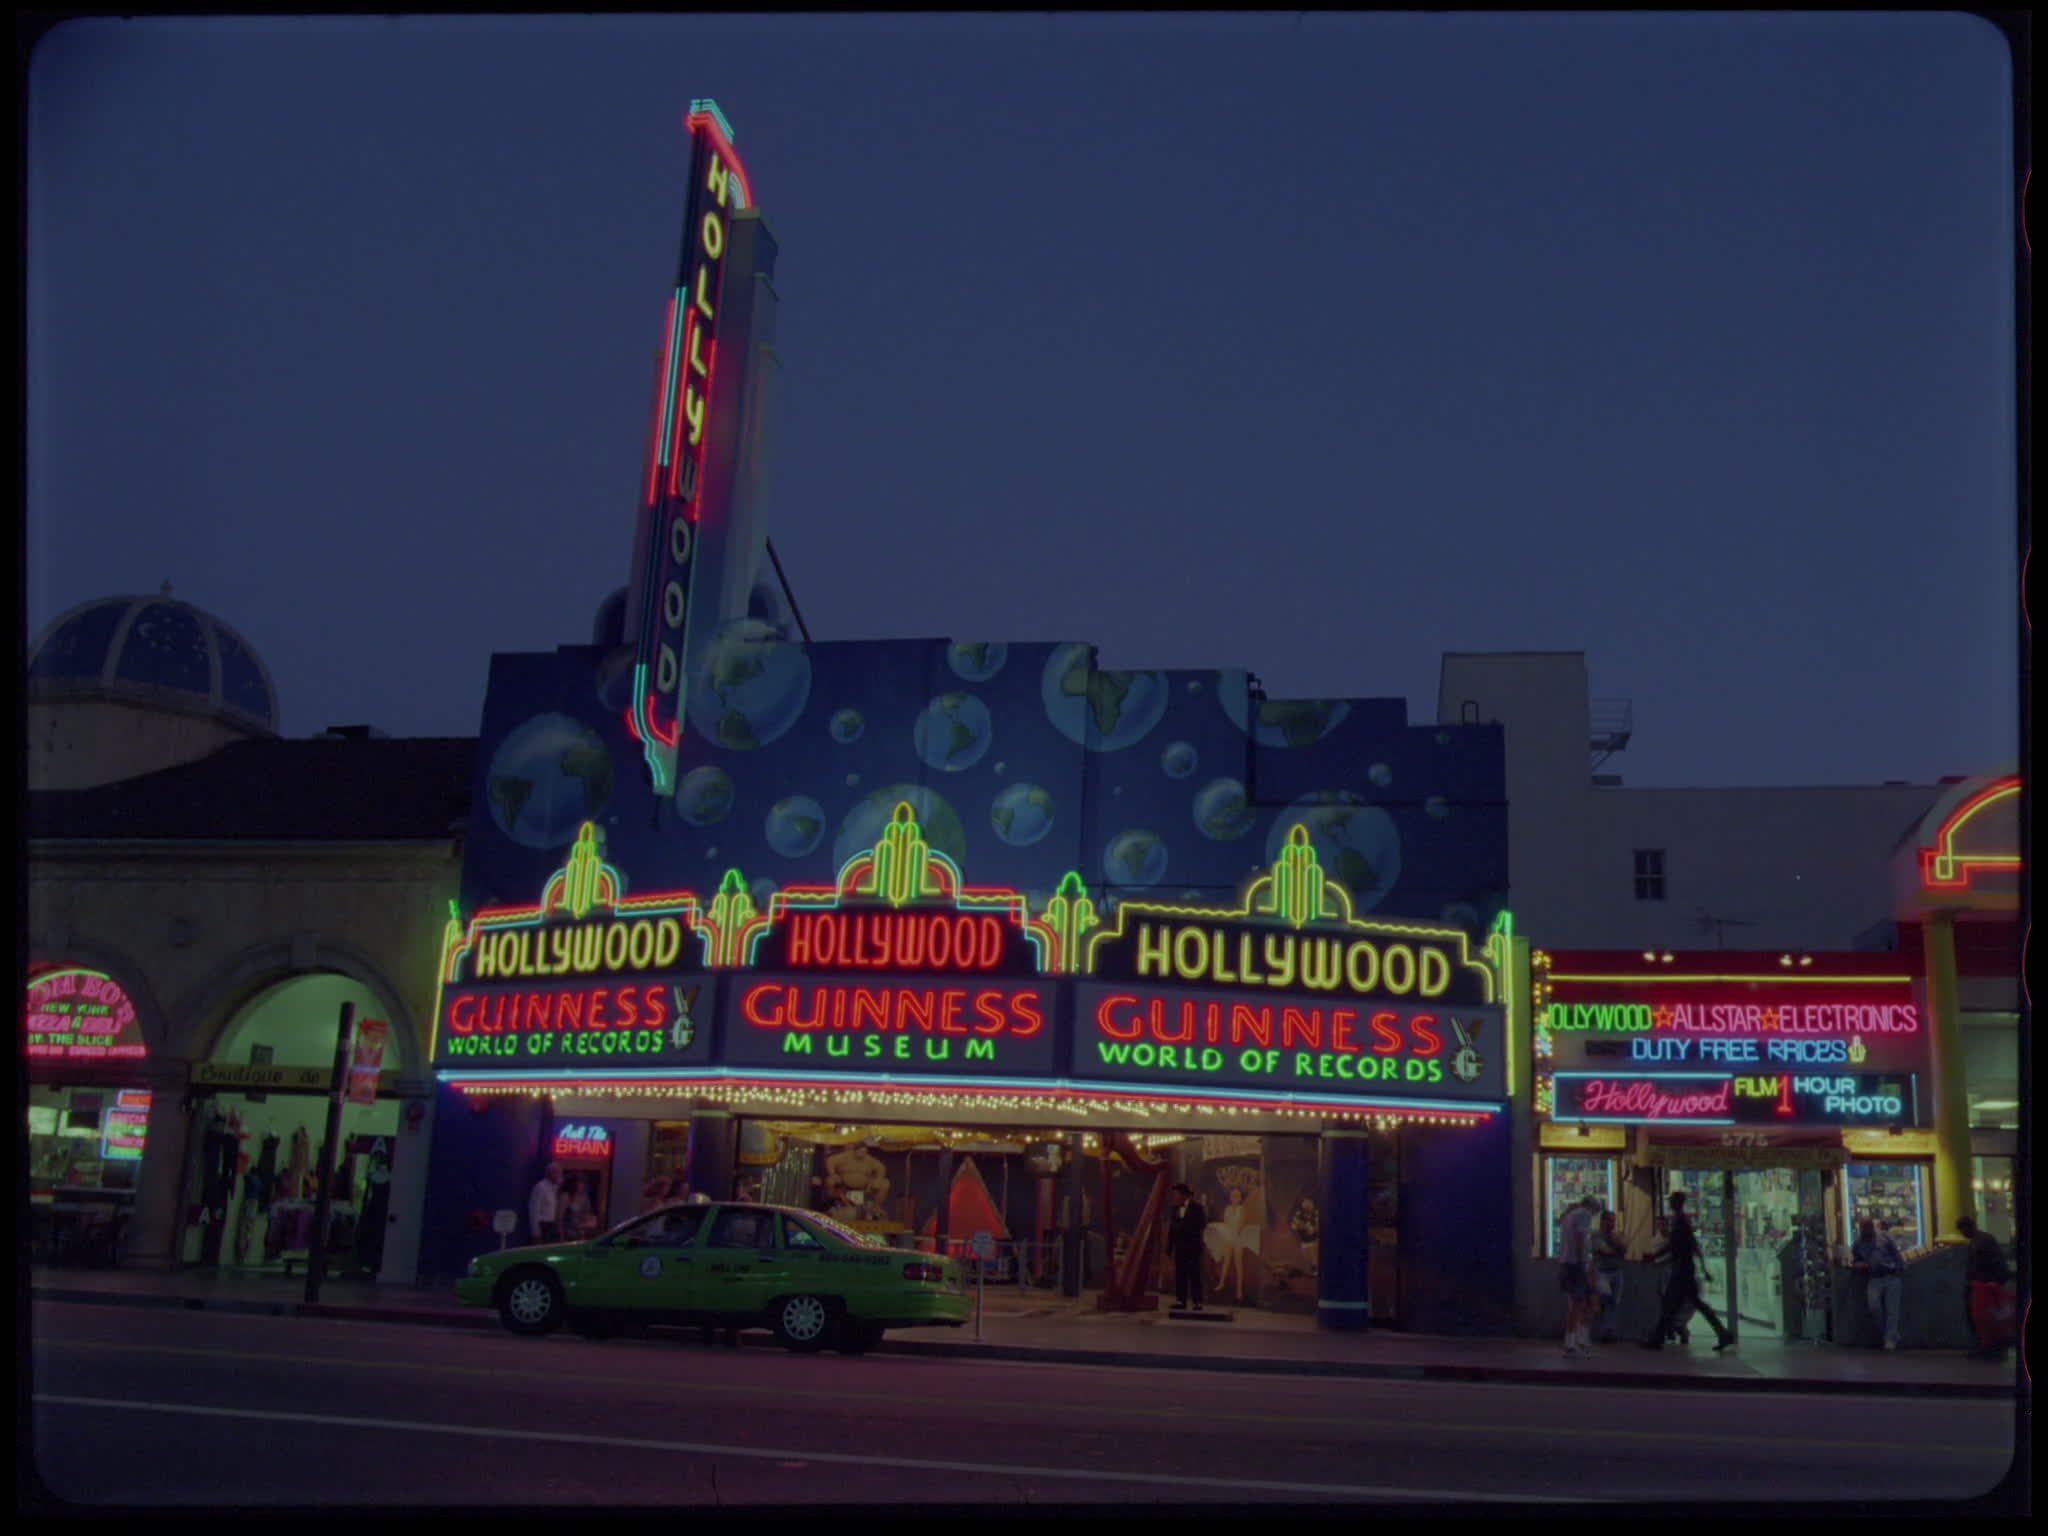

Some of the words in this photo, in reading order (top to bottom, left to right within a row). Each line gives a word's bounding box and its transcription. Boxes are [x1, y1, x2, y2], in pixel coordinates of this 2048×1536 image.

[656, 152, 728, 694] HOLLYWOOD
[475, 917, 682, 978] HOLLYWOOD
[789, 913, 1005, 969] HOLLYWOOD
[1136, 923, 1451, 998] HOLLYWOOD
[447, 984, 667, 1034] GUINNESS
[745, 983, 1043, 1035] GUINNESS
[1096, 994, 1443, 1056] GUINNESS
[1673, 1004, 1762, 1032] ALLSTAR
[1780, 1004, 1918, 1033] ELECTRONICS
[48, 1032, 74, 1045] THE
[77, 1034, 114, 1046] SLICE
[446, 1035, 517, 1057] WORLD
[527, 1033, 553, 1055] OF
[561, 1030, 665, 1054] RECORDS
[782, 1033, 996, 1061] MUSEUM
[1632, 1037, 1692, 1060] DUTY
[1699, 1038, 1760, 1061] FREE
[1098, 1042, 1224, 1072] WORLD
[1240, 1049, 1281, 1073] OF
[1295, 1053, 1443, 1084] RECORDS
[1583, 1080, 1731, 1118] Hollywood
[1734, 1075, 1778, 1097] FILM
[1776, 1075, 1793, 1114] 1
[1793, 1076, 1856, 1096] HOUR
[1824, 1095, 1902, 1115] PHOTO
